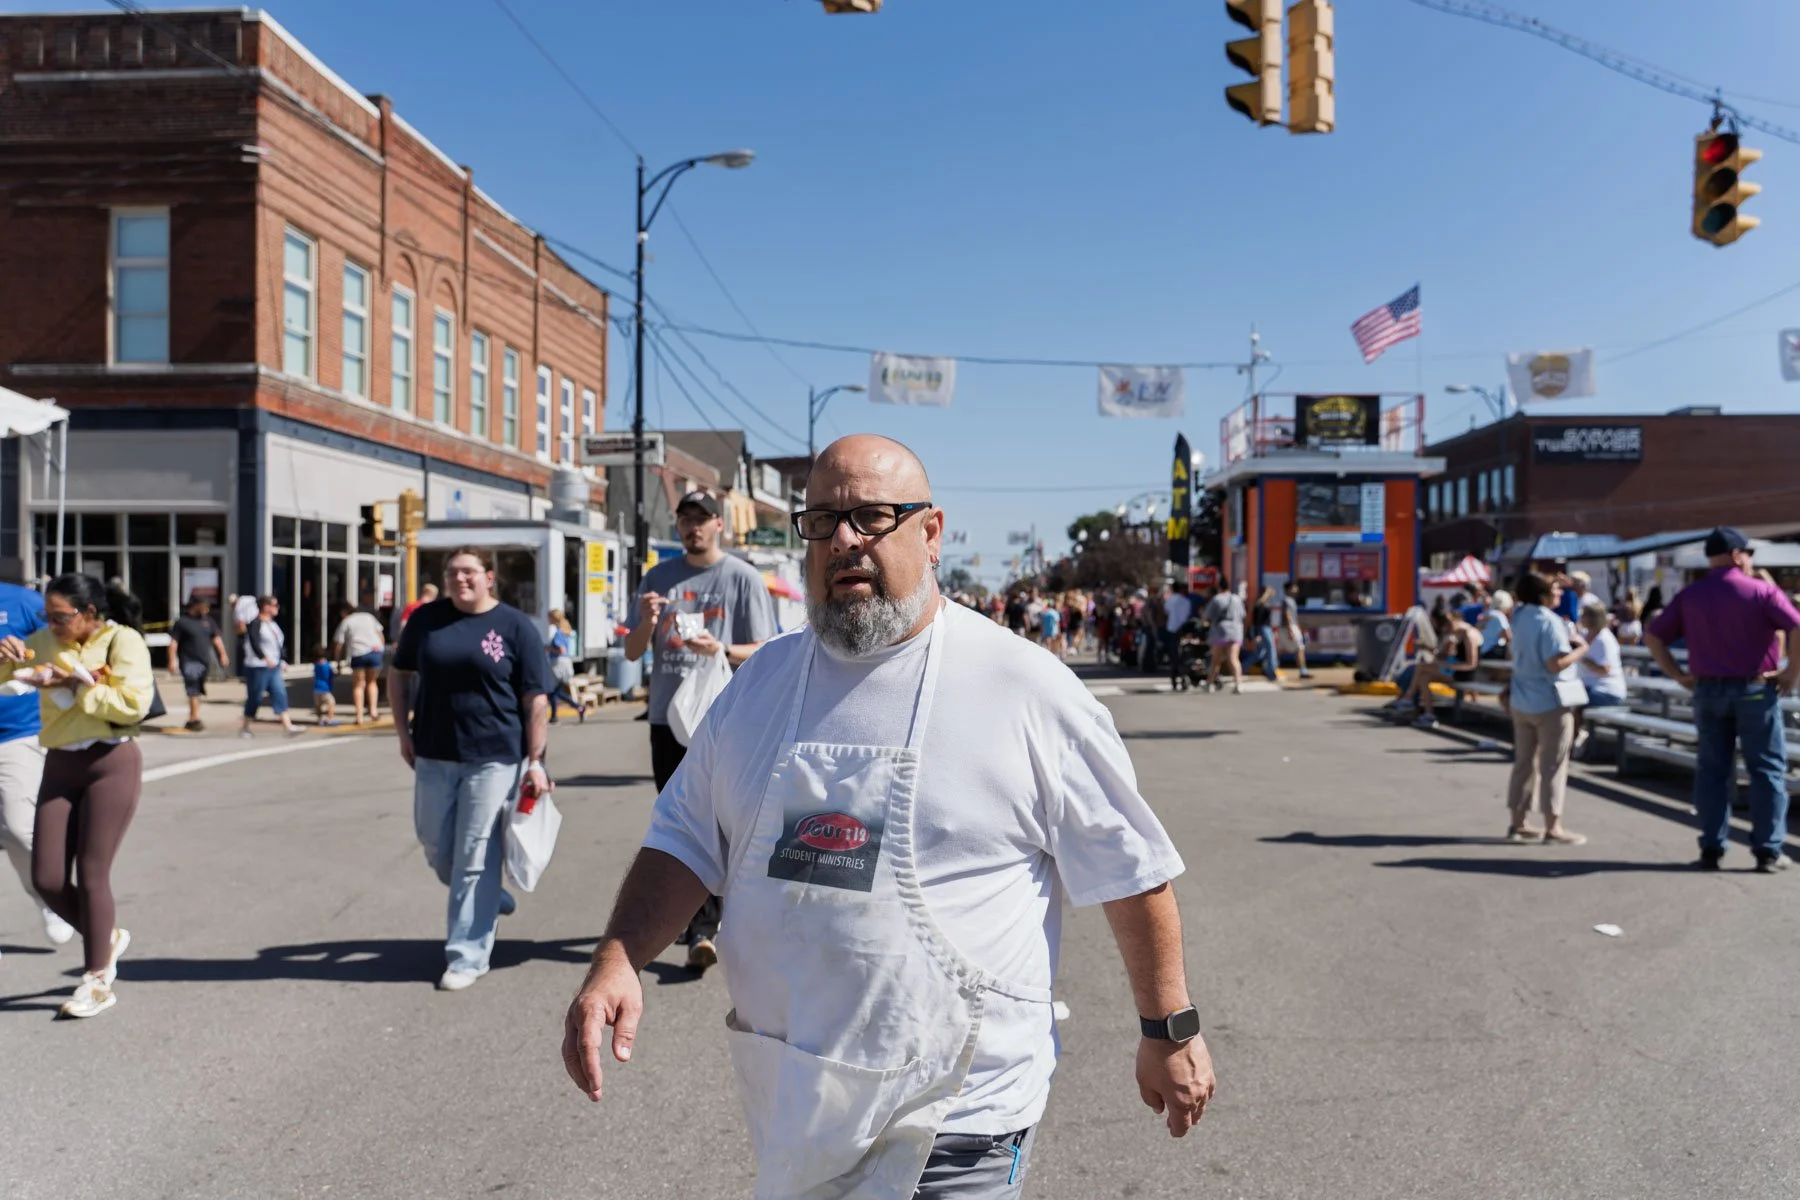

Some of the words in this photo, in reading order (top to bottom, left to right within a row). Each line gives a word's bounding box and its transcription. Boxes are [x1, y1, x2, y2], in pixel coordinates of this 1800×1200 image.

[1167, 457, 1188, 540] ATM
[780, 847, 816, 863] STUDENT
[818, 853, 865, 870] MINISTRIES
